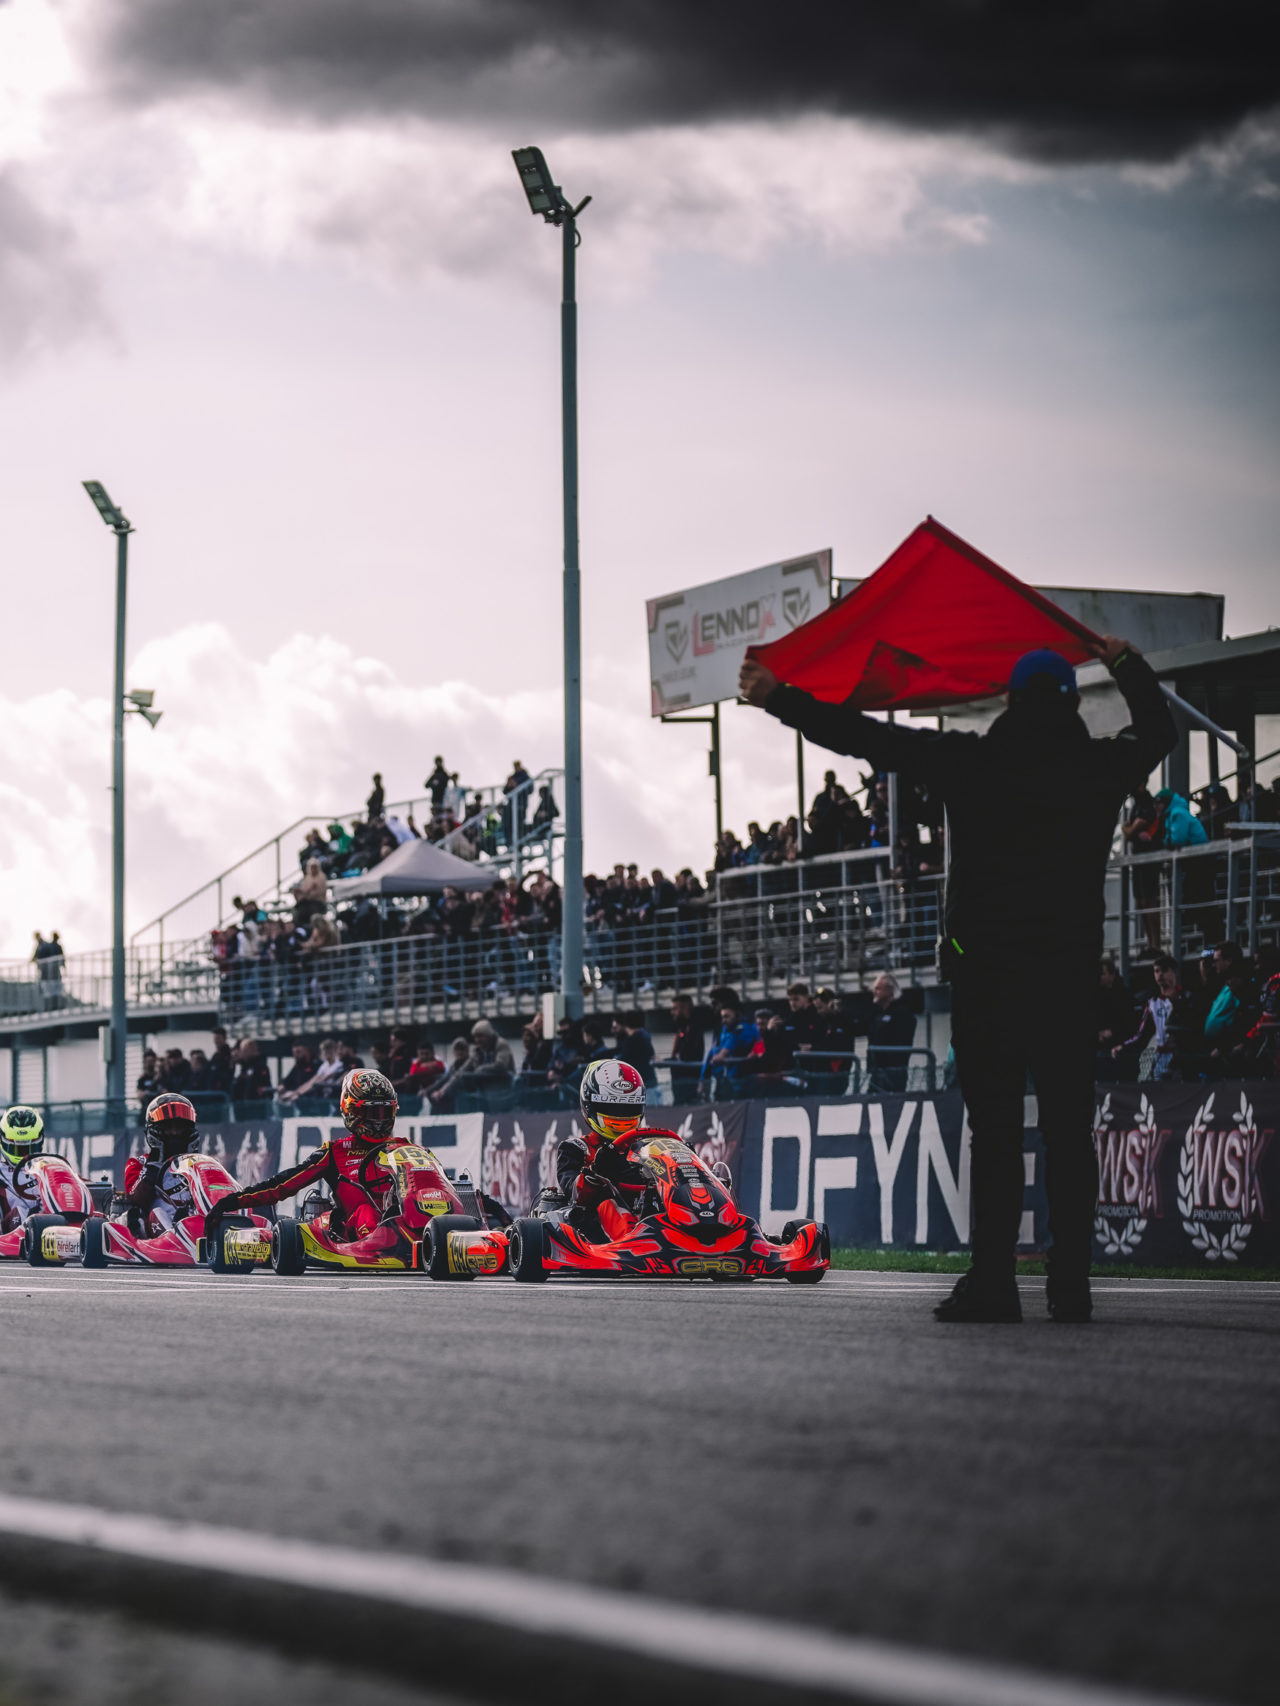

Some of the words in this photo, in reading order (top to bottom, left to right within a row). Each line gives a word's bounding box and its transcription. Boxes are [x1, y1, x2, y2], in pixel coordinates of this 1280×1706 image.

[1095, 1129, 1172, 1218] WSK
[1193, 1129, 1275, 1220] WSK
[1098, 1205, 1139, 1217] PROMOTION
[1192, 1208, 1241, 1221] PROMOTION
[681, 1261, 738, 1273] CRG
